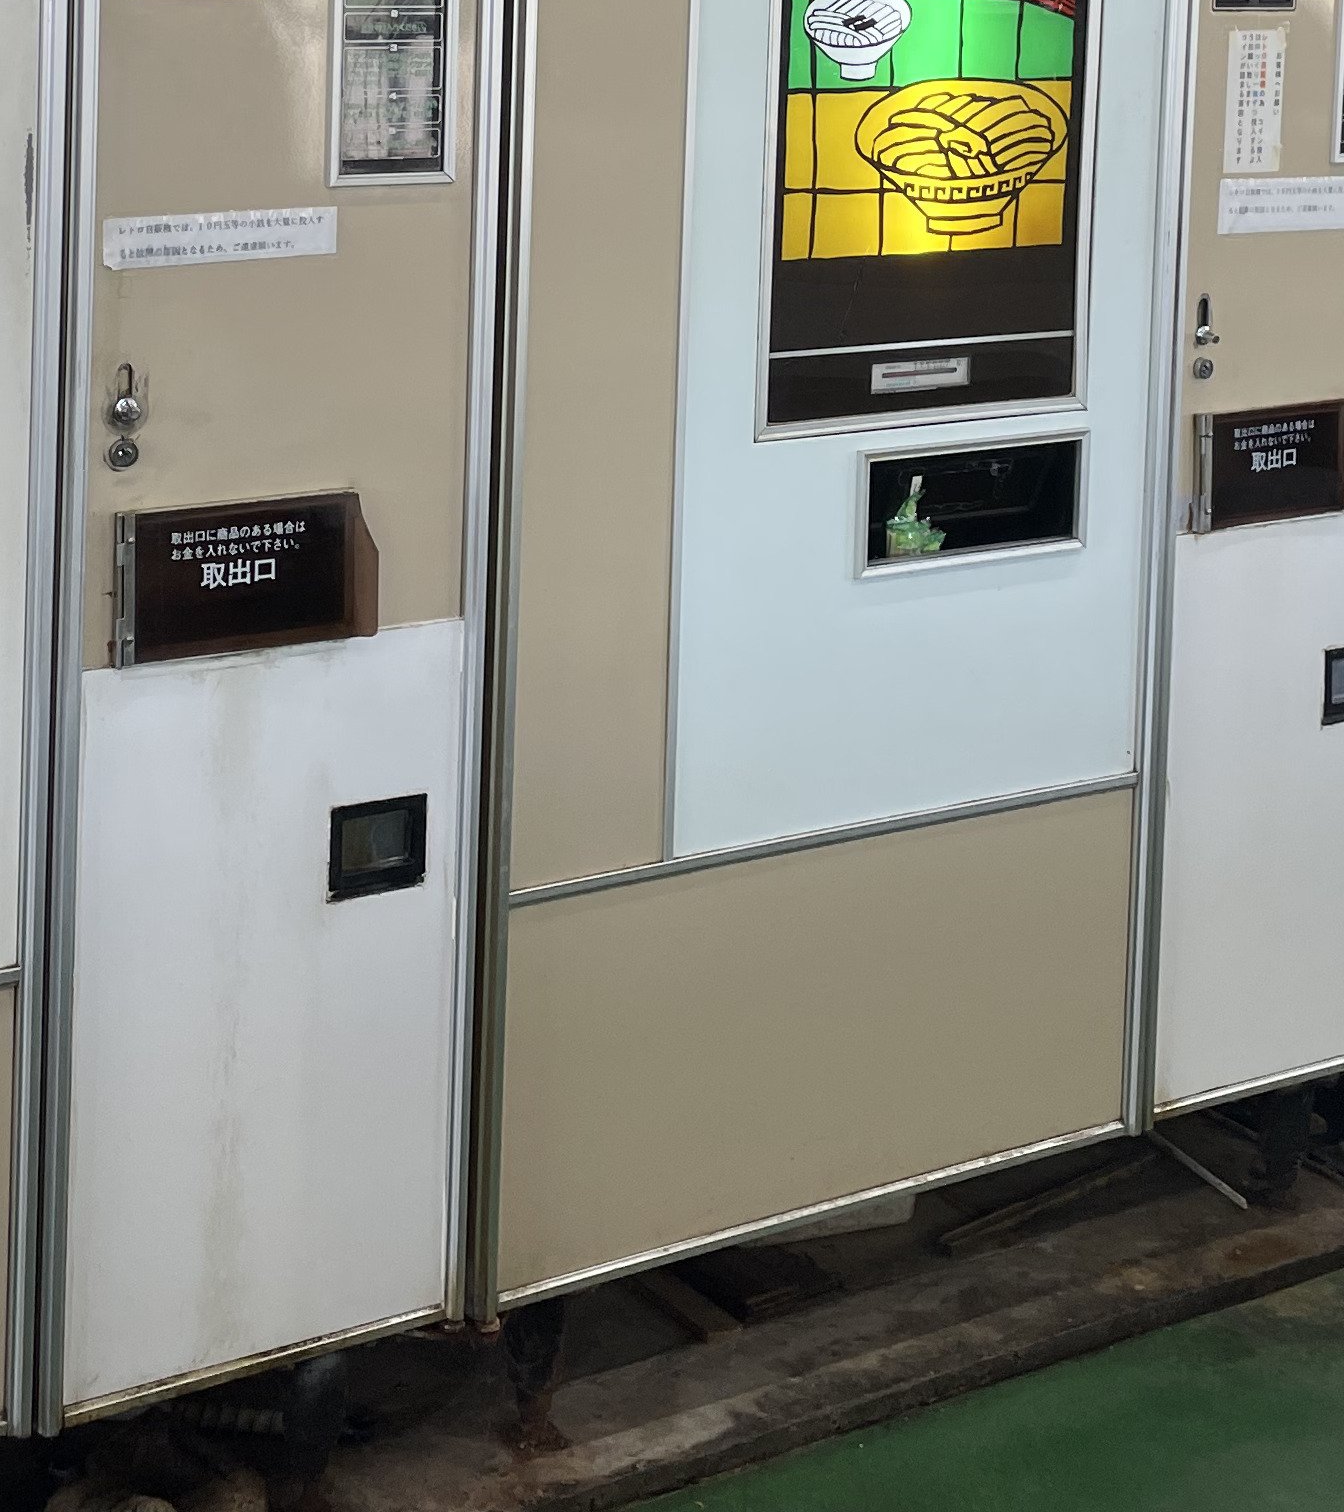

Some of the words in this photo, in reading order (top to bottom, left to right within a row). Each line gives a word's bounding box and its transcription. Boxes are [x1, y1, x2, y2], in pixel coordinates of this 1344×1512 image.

[1250, 448, 1297, 472] 取出口
[170, 521, 306, 545] 取出口に商品のある場合は
[171, 538, 300, 560] お金を入れないで下さい。
[200, 558, 276, 589] 取出口
